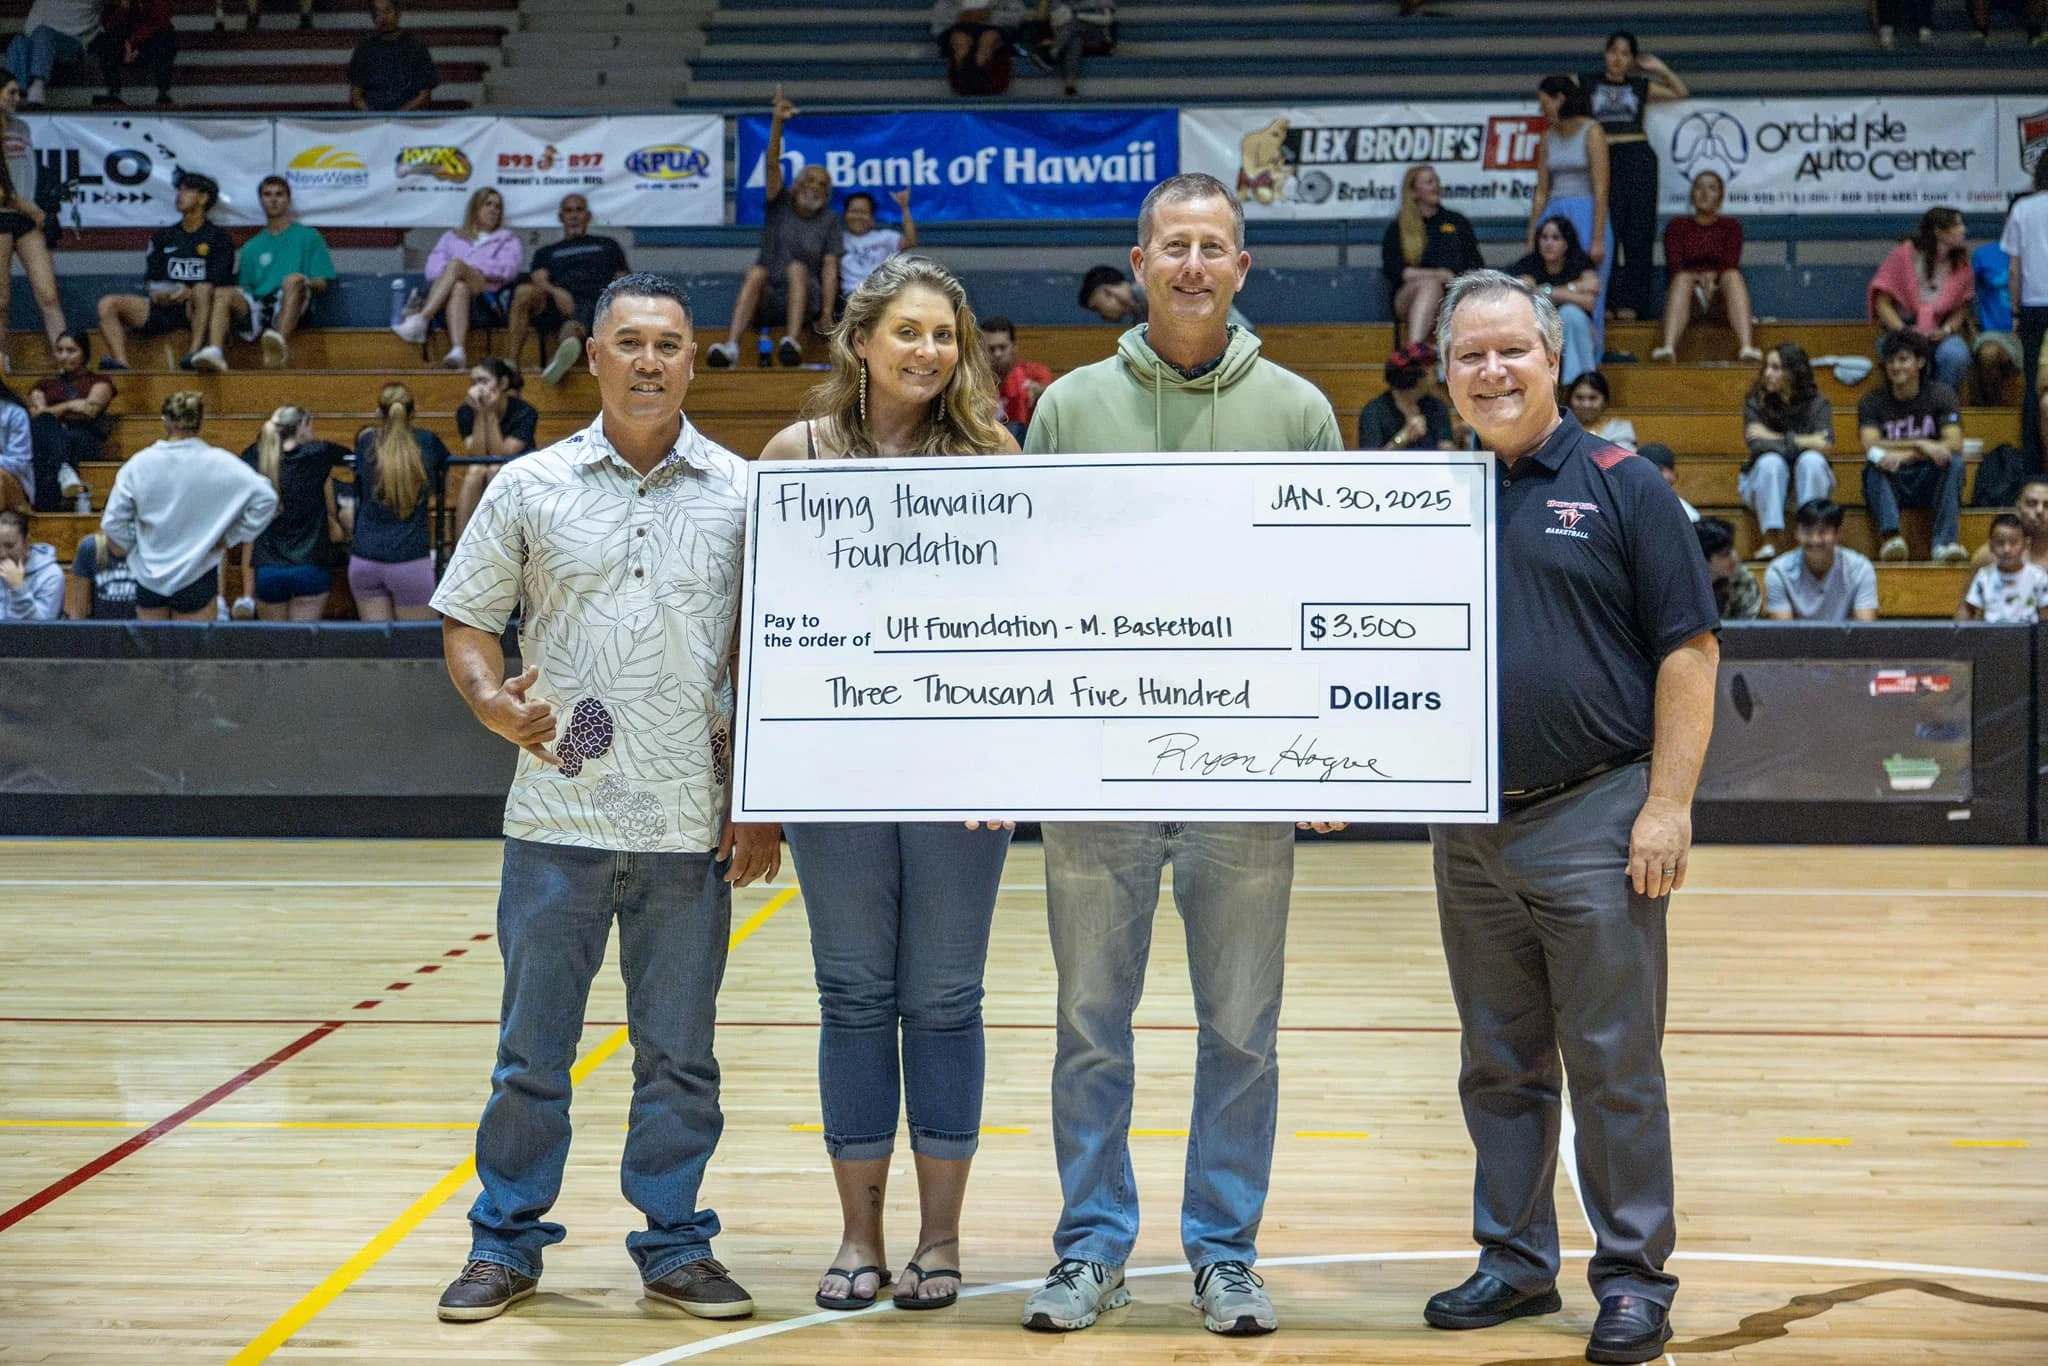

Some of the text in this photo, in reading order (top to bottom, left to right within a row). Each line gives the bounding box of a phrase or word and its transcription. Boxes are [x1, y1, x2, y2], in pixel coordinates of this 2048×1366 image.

[1302, 121, 1542, 165] LEX BRODIE'S Tir
[1756, 112, 1907, 153] Orchid Isle
[33, 148, 152, 186] ILO
[631, 149, 710, 178] KPUA
[826, 141, 1156, 187] Bank of Hawaii
[1795, 147, 1977, 181] Auto Center
[776, 482, 1033, 538] Flying Hawaiian
[827, 532, 999, 569] Foundation
[764, 614, 820, 632] Pay to
[764, 632, 872, 648] the order of
[886, 616, 919, 643] UH
[927, 613, 1059, 641] Foundation
[1080, 616, 1107, 638] M.
[1113, 615, 1233, 638] Basketball
[825, 673, 1251, 709] Three Thousand Five Hundred
[1329, 685, 1442, 711] Dollars
